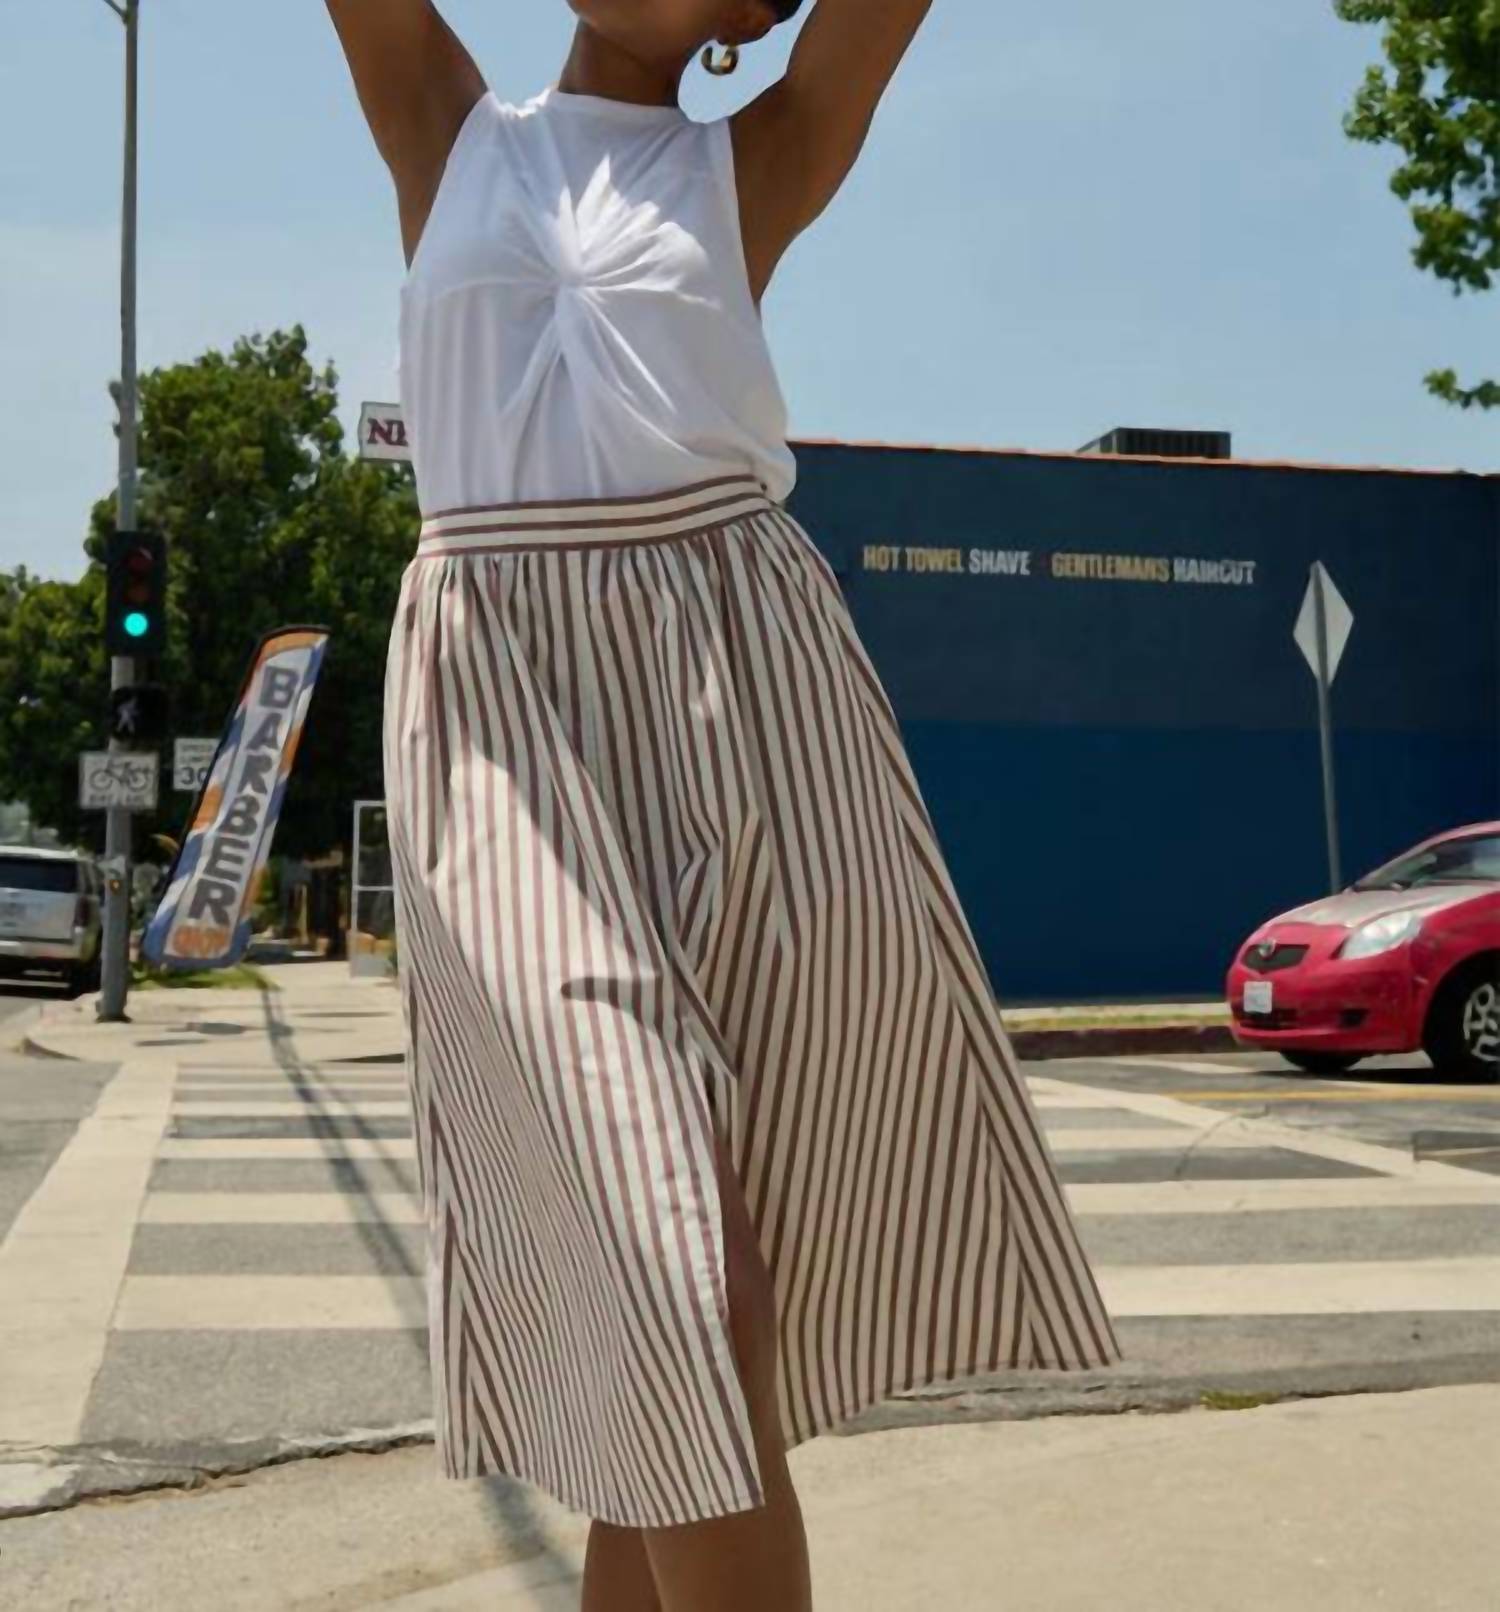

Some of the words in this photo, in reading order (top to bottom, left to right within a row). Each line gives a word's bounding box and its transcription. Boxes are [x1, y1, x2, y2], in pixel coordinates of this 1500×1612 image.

[863, 546, 901, 571] HOT
[904, 547, 965, 573] TOWEL
[968, 548, 1031, 576] SHAVE
[1173, 557, 1257, 585] HAIRCUT
[188, 666, 299, 926] BARBER
